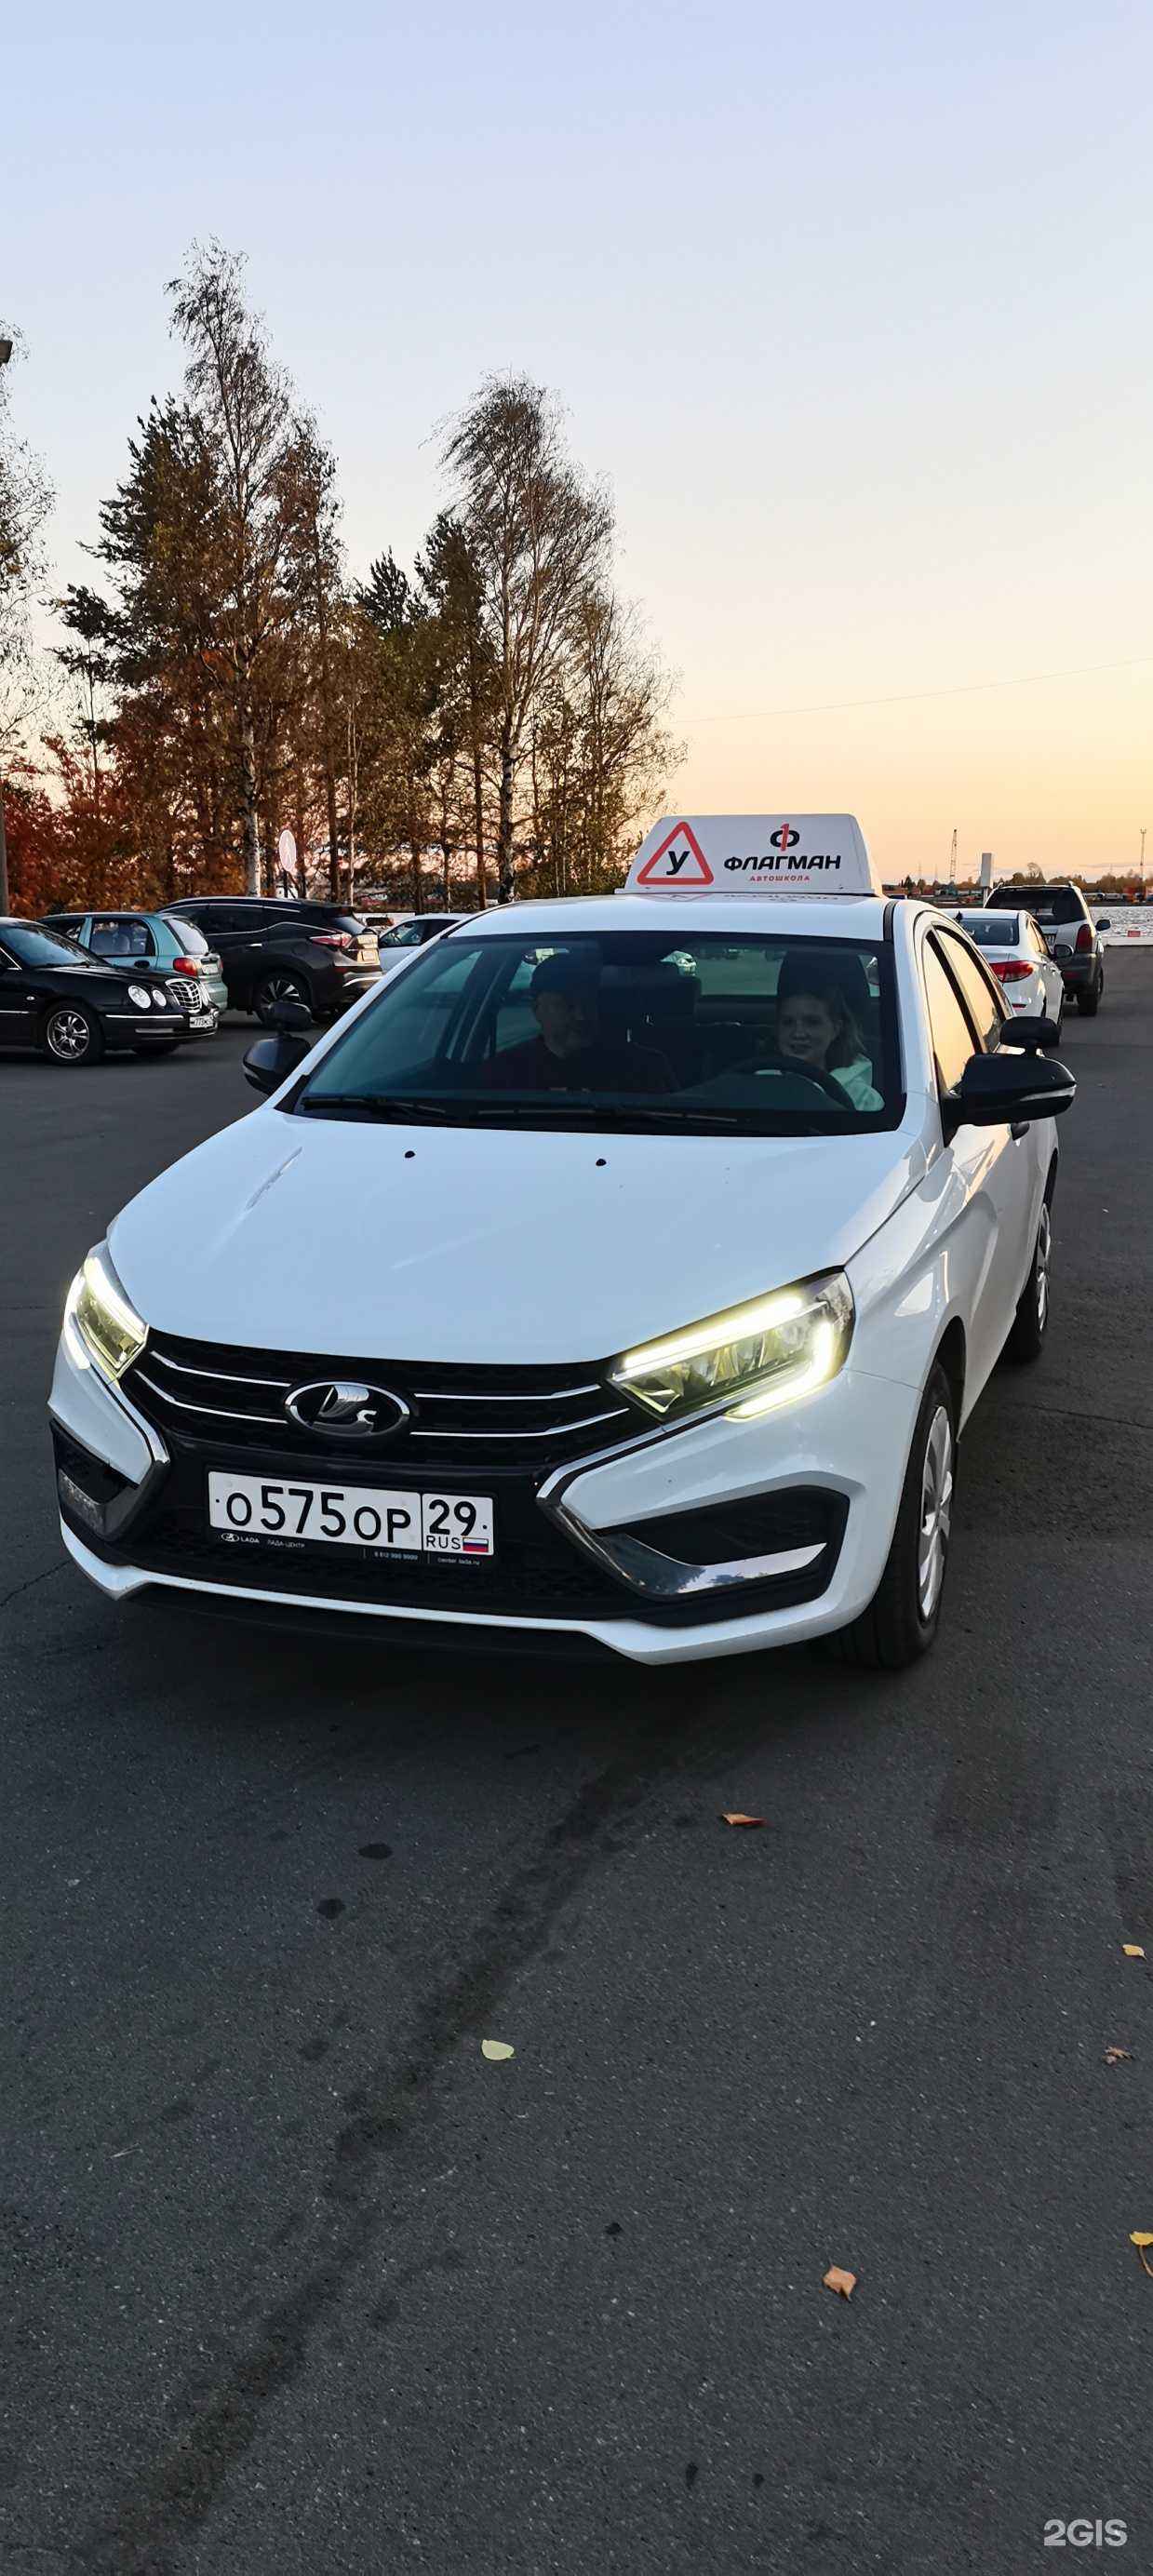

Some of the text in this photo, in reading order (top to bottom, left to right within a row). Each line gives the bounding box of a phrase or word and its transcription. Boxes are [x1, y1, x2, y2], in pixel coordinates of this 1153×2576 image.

[666, 851, 690, 876] У
[723, 854, 841, 871] ФЛАГМАН
[428, 1498, 477, 1536] 29
[240, 1536, 261, 1544] LADA
[425, 1536, 462, 1550] RUS
